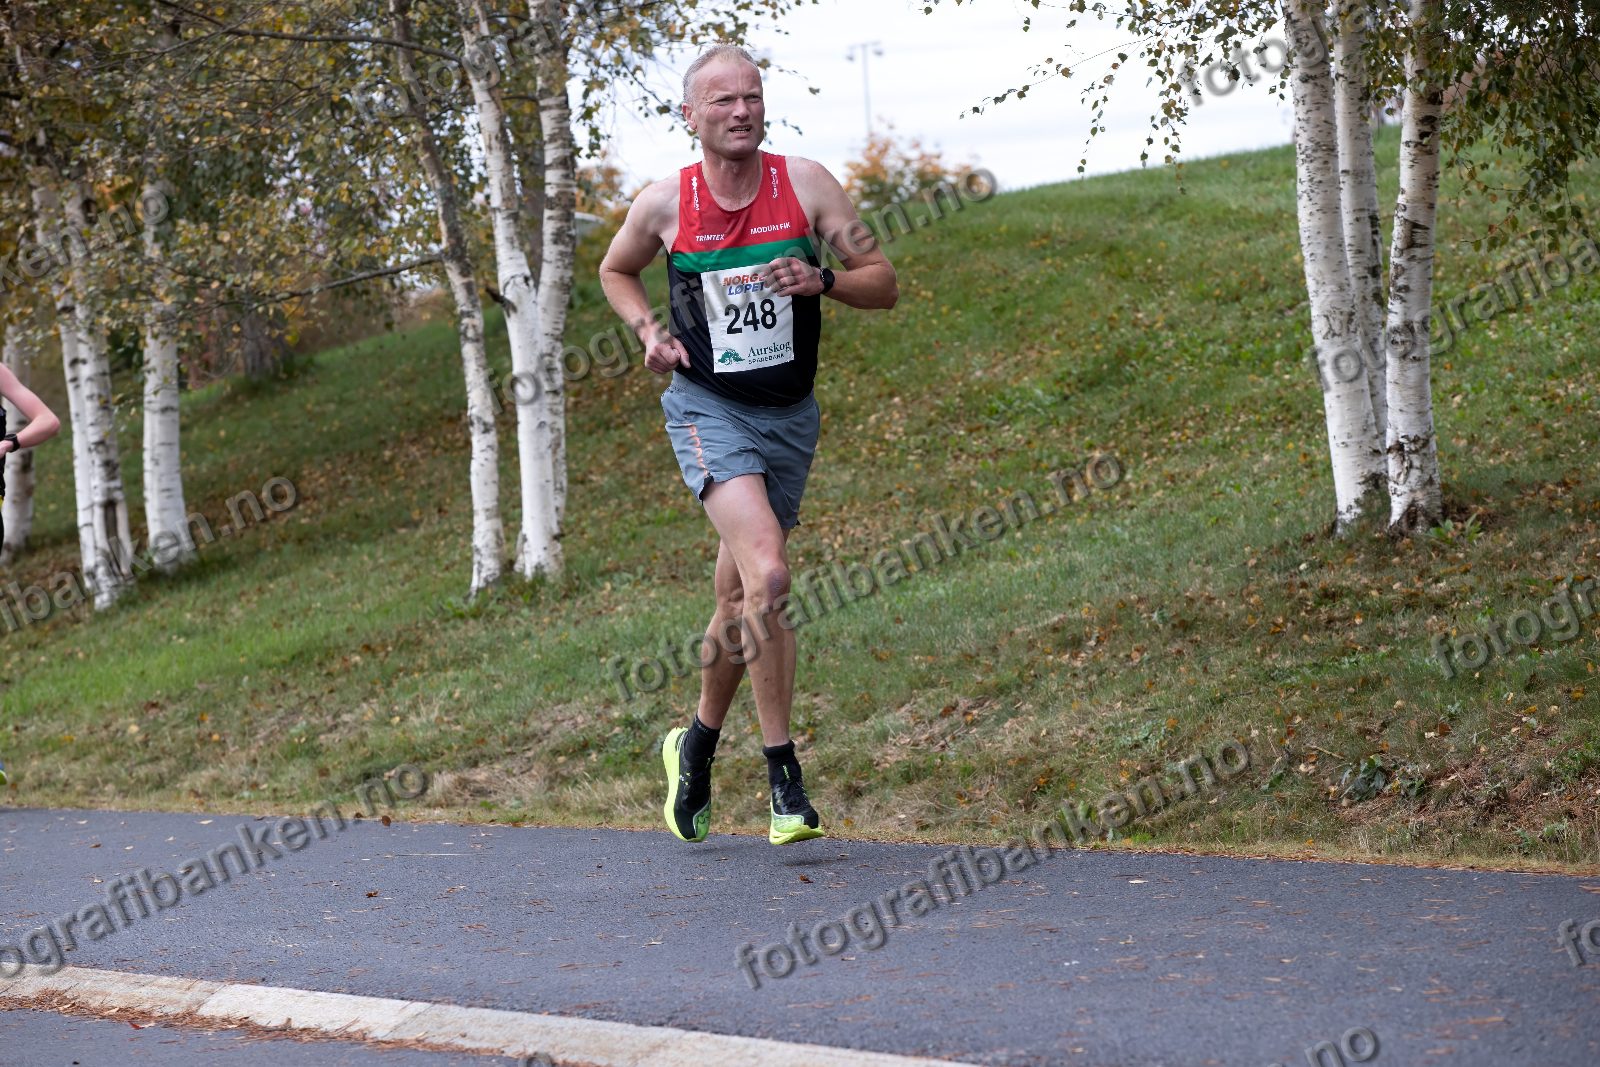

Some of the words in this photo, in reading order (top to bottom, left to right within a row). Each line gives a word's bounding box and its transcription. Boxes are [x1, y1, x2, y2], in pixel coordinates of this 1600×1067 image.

[751, 224, 779, 234] MODUM
[780, 222, 791, 230] FIK
[725, 299, 777, 334] 248
[748, 341, 792, 358] Aurskog
